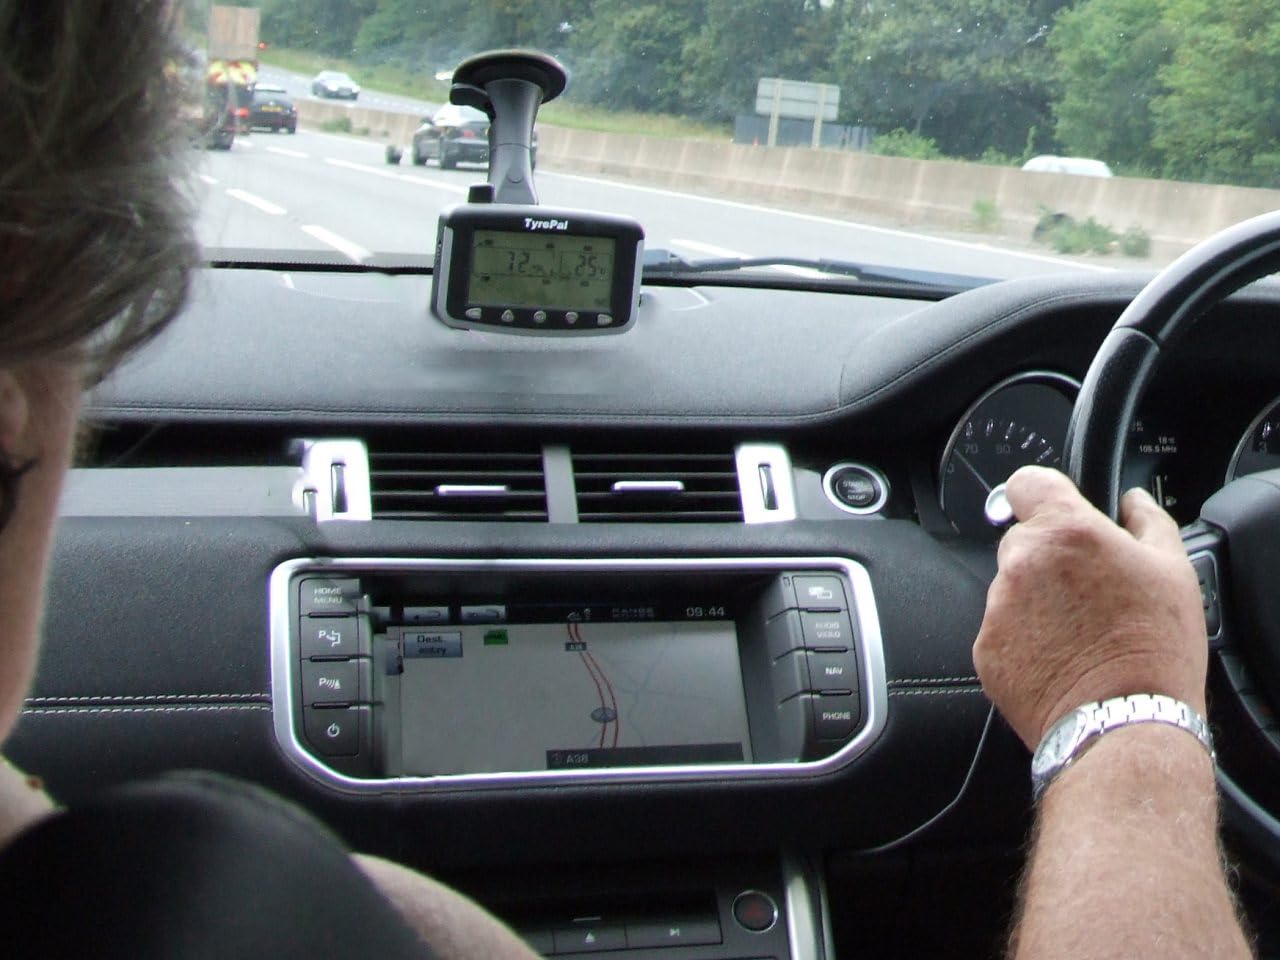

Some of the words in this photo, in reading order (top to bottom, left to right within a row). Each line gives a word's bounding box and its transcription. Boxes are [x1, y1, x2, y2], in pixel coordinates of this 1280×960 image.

[523, 217, 569, 231] TyrePal
[314, 587, 342, 595] HOME
[313, 595, 343, 604] MENU
[825, 666, 843, 675] NAV
[822, 711, 851, 721] PHONE
